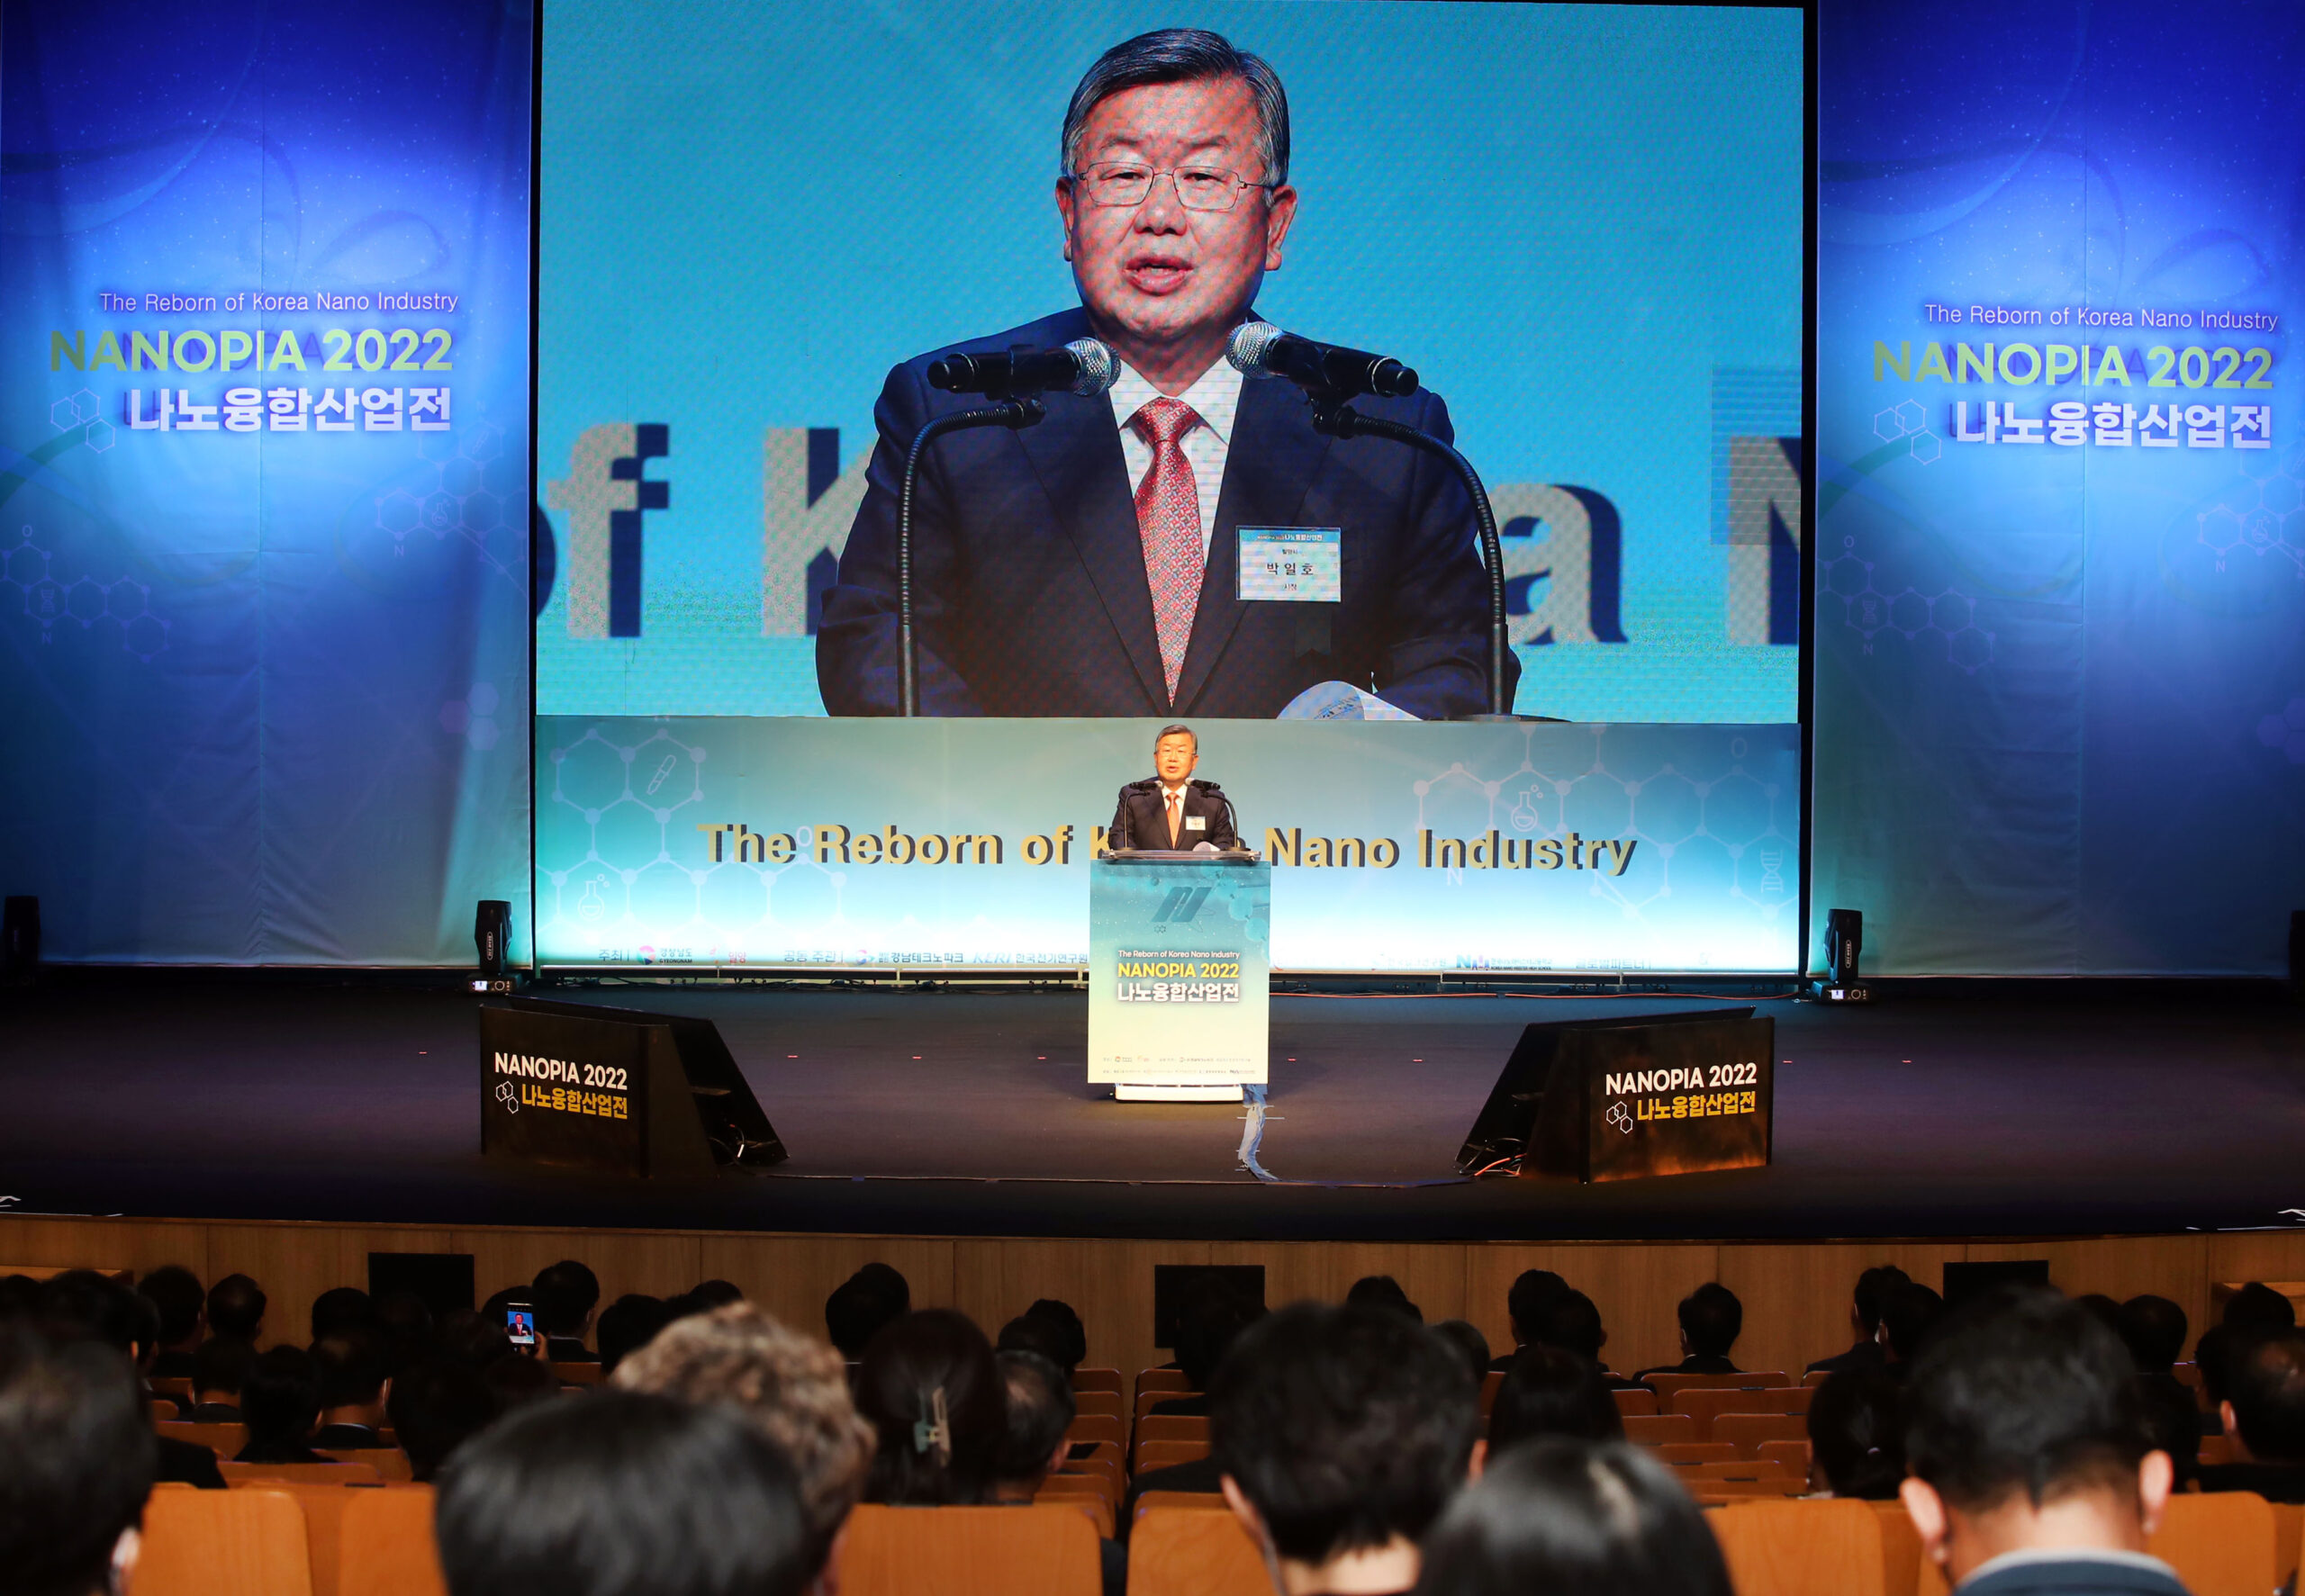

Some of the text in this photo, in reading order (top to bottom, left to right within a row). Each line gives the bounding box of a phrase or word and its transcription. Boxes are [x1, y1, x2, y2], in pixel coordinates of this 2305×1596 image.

[100, 292, 458, 313] The Reborn of Korea Nano Industry
[1925, 304, 2278, 332] The Reborn of Korea Nano Industry
[50, 329, 453, 373] NANOPIA 2022
[1873, 340, 2273, 389] NANOPIA 2022
[131, 387, 450, 431] 나노융합산업전
[1957, 401, 2271, 449] 나노융합산업전
[696, 824, 797, 863] The
[814, 824, 1003, 865] Reborn
[1021, 825, 1073, 865] of
[1264, 827, 1637, 877] Nano Industry
[1117, 962, 1239, 978] NANOPIA 2022
[1118, 950, 1240, 960] The Reborn of Korea Nano Industry
[1117, 982, 1239, 1003] 나노융합산업전
[495, 1051, 628, 1090] NANOPIA 2022
[1605, 1062, 1757, 1096] NANOPIA 2022
[521, 1083, 628, 1120] 나노융합산업전
[1637, 1091, 1756, 1121] 나노융합산업전
